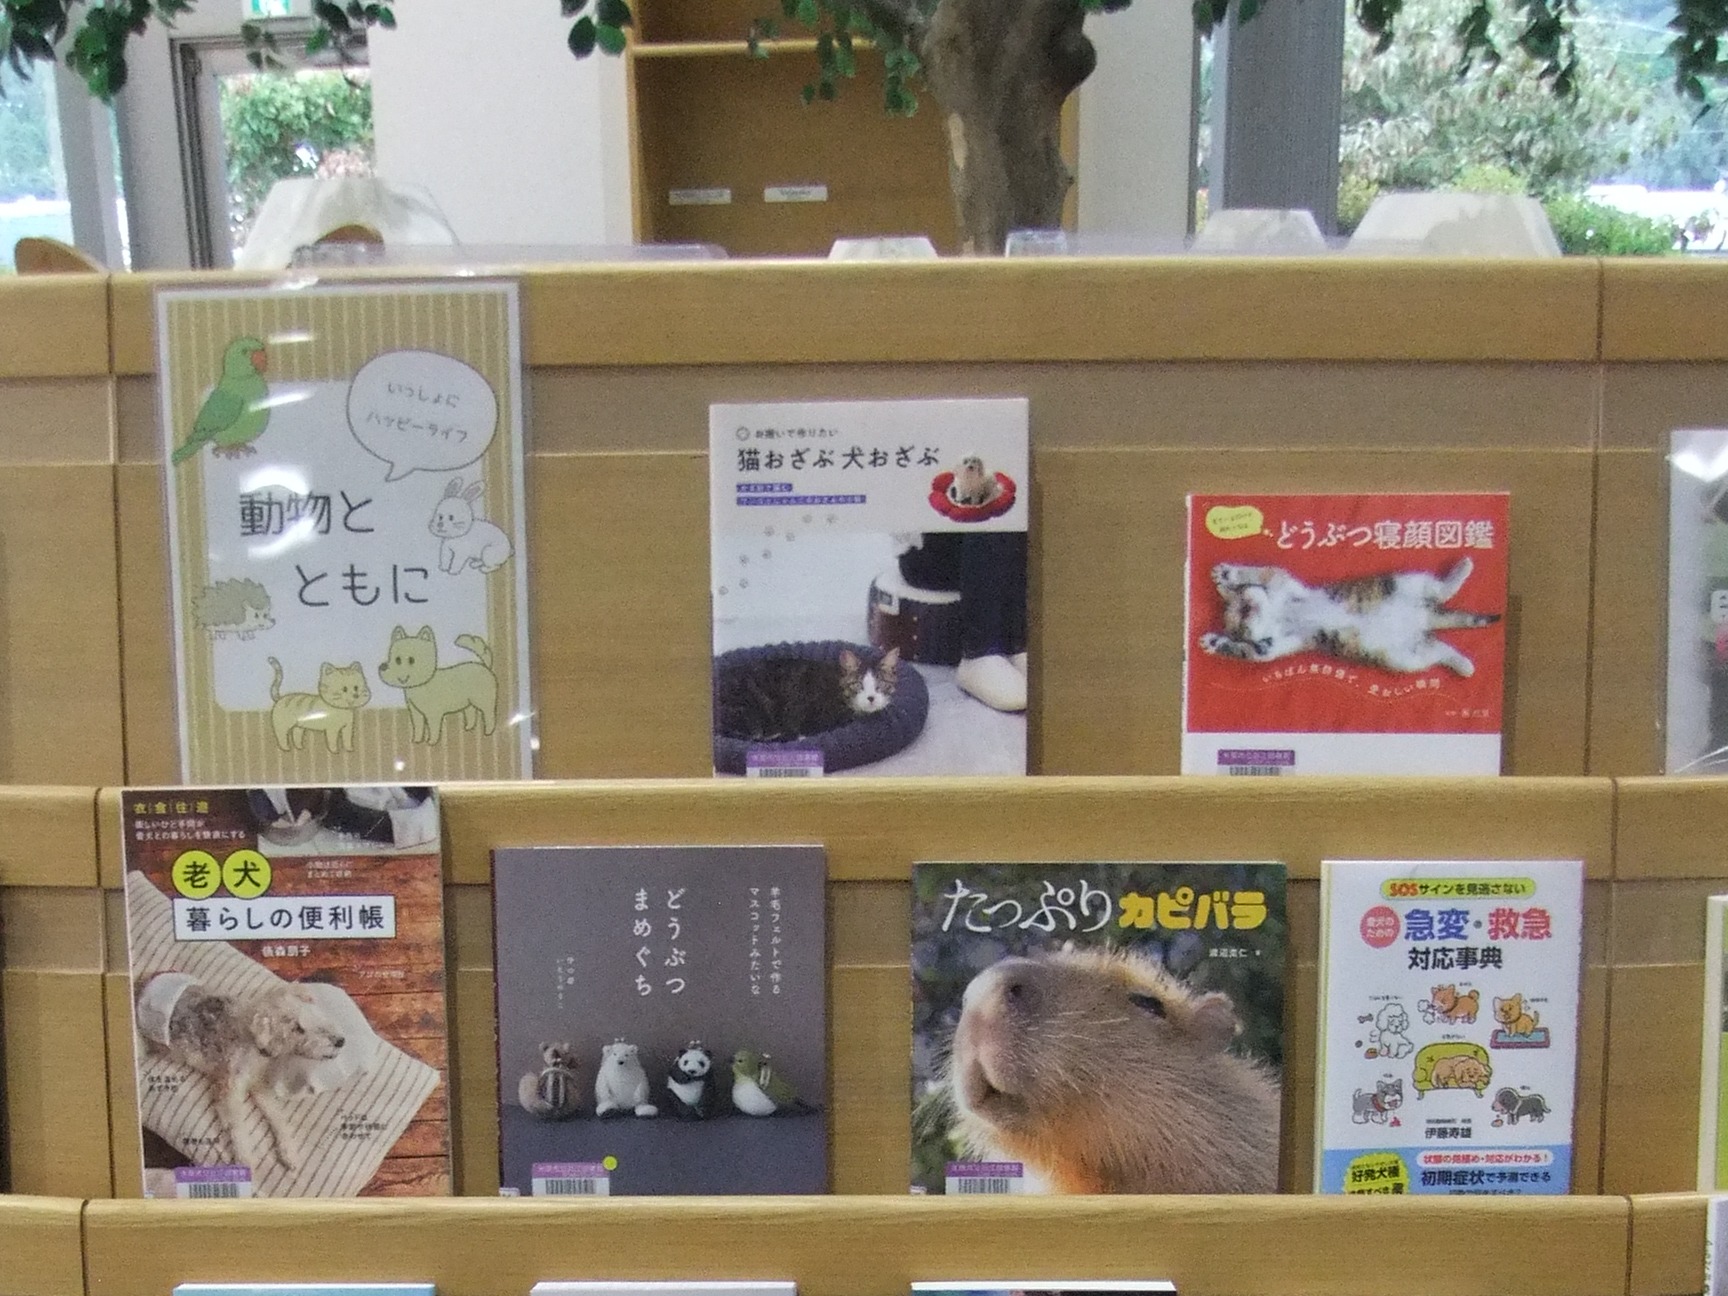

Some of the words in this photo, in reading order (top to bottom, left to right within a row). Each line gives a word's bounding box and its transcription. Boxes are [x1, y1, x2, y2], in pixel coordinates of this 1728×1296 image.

[366, 411, 467, 442] ハッピーライフ
[239, 491, 374, 537] 動物と
[1276, 520, 1494, 550] どうぶつ寝顔図鑑
[296, 564, 429, 606] ともに
[182, 860, 261, 890] 老犬
[186, 905, 385, 932] 暮らしの便利帳
[1404, 907, 1552, 941] 急変・救急
[633, 887, 652, 996] まめぐち
[664, 887, 687, 994] どうぶつ
[1408, 947, 1503, 970] 対応事典
[1421, 1170, 1551, 1187] 初期症状で予測できる
